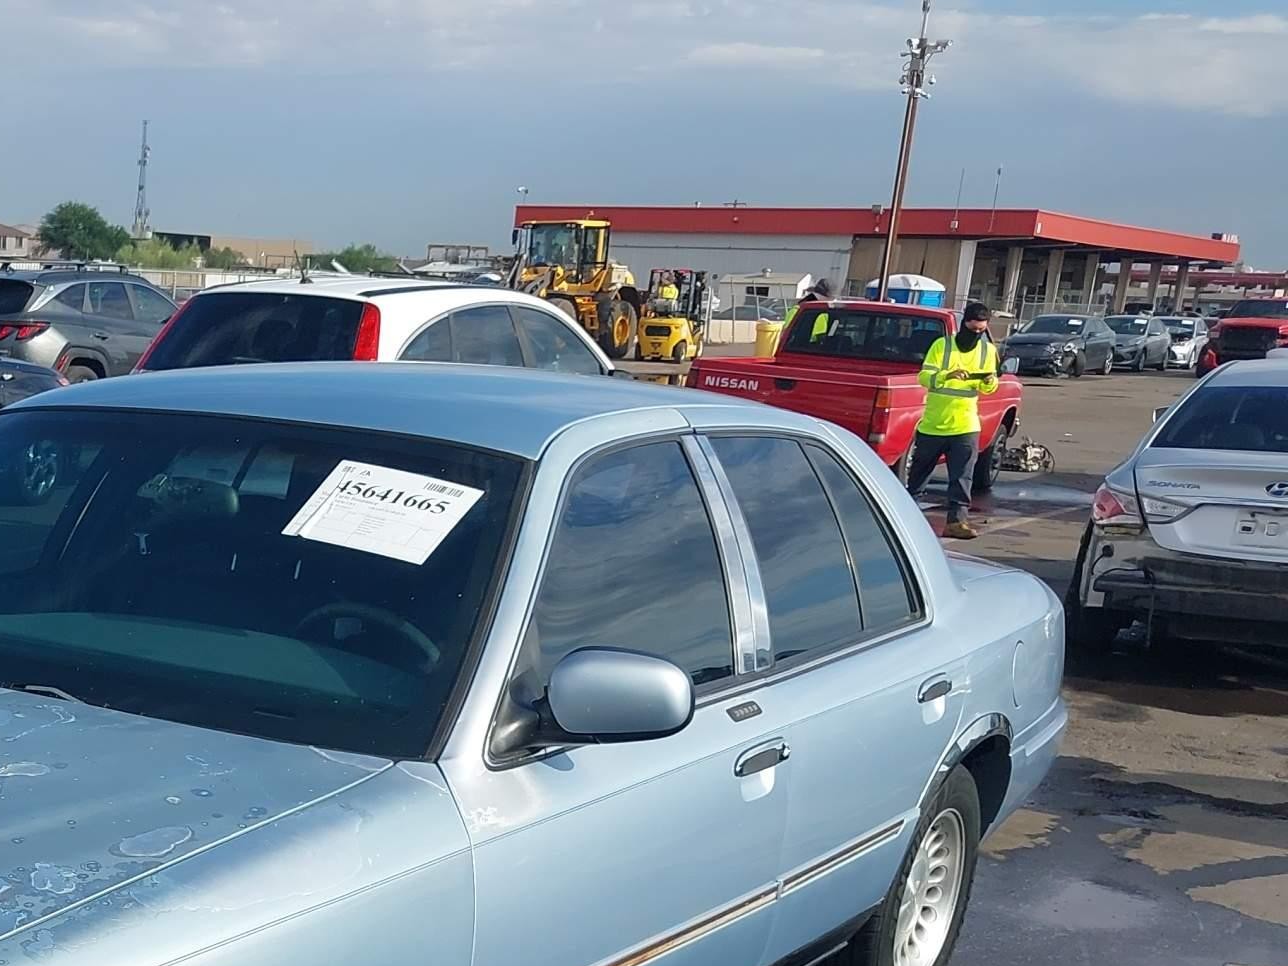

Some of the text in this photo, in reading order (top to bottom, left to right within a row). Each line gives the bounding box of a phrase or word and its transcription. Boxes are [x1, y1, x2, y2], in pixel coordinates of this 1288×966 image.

[705, 375, 759, 390] NISSAN
[1145, 480, 1201, 490] SONATA
[337, 479, 451, 514] 45641665
